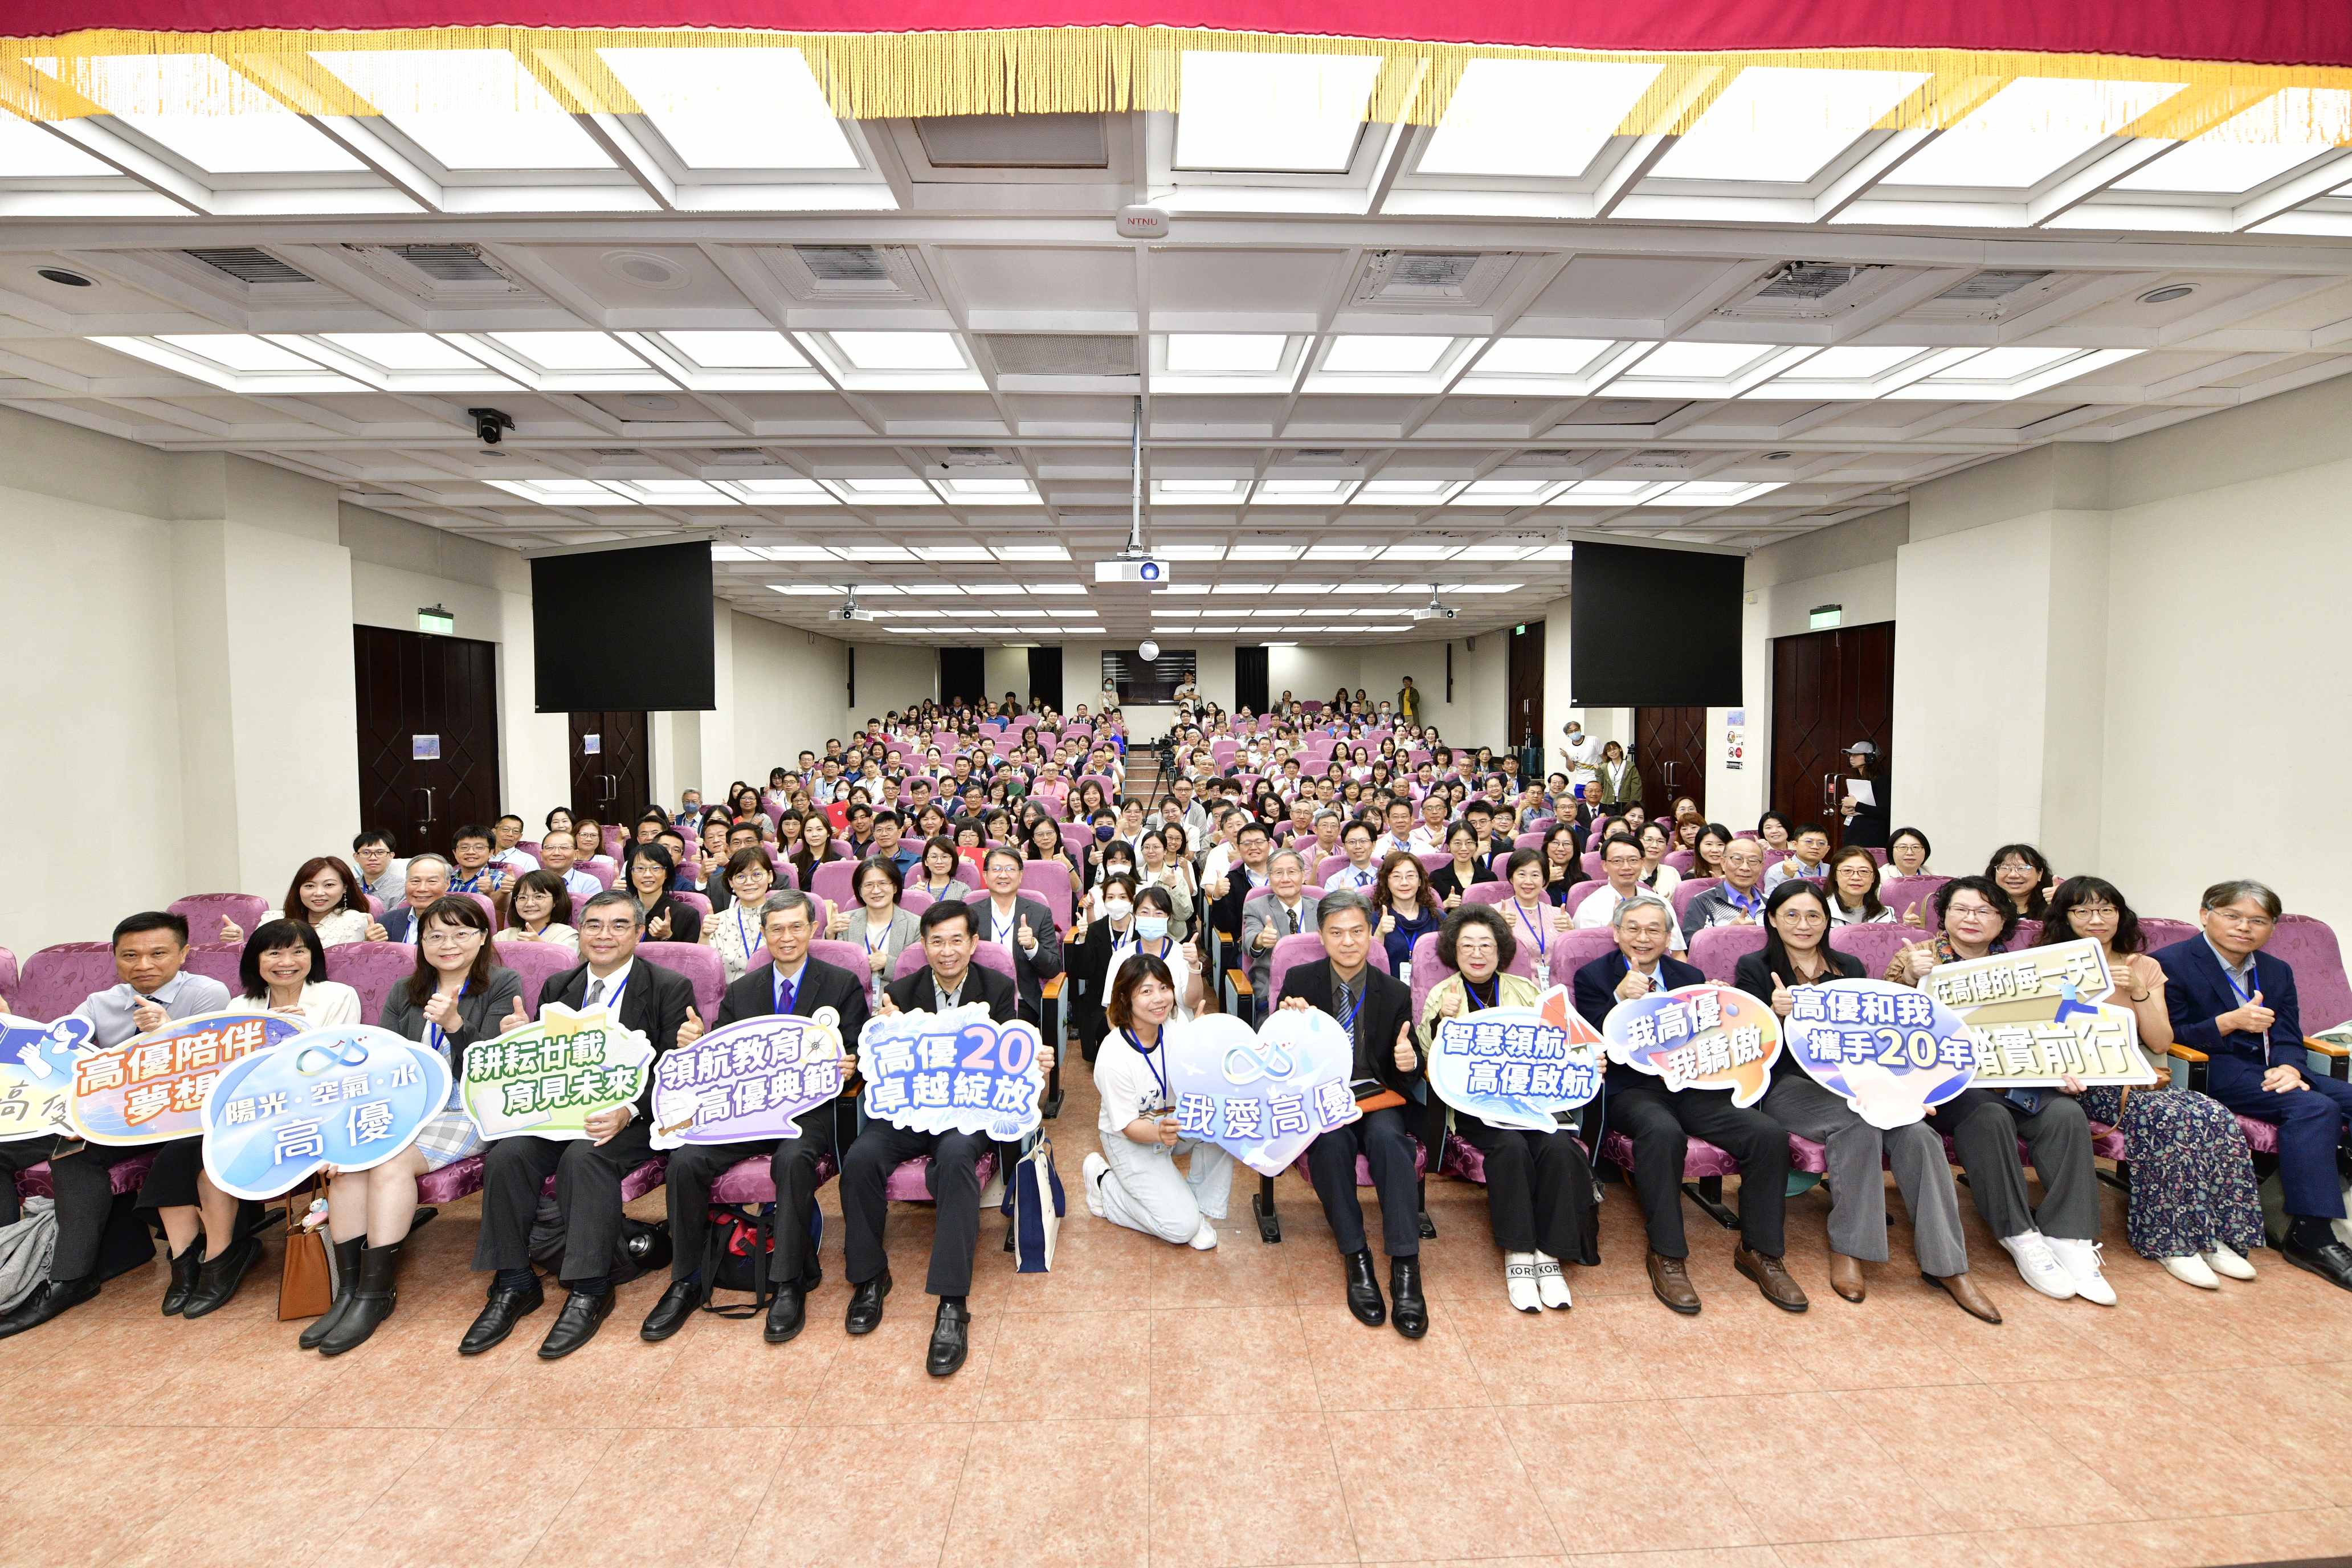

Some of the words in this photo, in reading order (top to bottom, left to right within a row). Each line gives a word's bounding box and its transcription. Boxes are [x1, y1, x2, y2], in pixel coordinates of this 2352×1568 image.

[1627, 990, 1721, 1052] 我高優
[1792, 989, 1932, 1026] 高優和我
[77, 1020, 265, 1096] 高優陪伴
[469, 1031, 605, 1081] 耕耘廿載
[660, 1028, 803, 1089] 領航教育
[875, 1024, 1034, 1076] 高優20
[1443, 1022, 1566, 1059] 智慧領航
[1668, 1023, 1764, 1085] 我驕傲
[1808, 1028, 1975, 1069] 攜手20年
[503, 1066, 637, 1114] 育見未來
[695, 1061, 839, 1125] 高優典範
[874, 1073, 1034, 1114] 卓越綻放
[1178, 1077, 1354, 1139] 我愛高優
[272, 1099, 397, 1165] 高優
